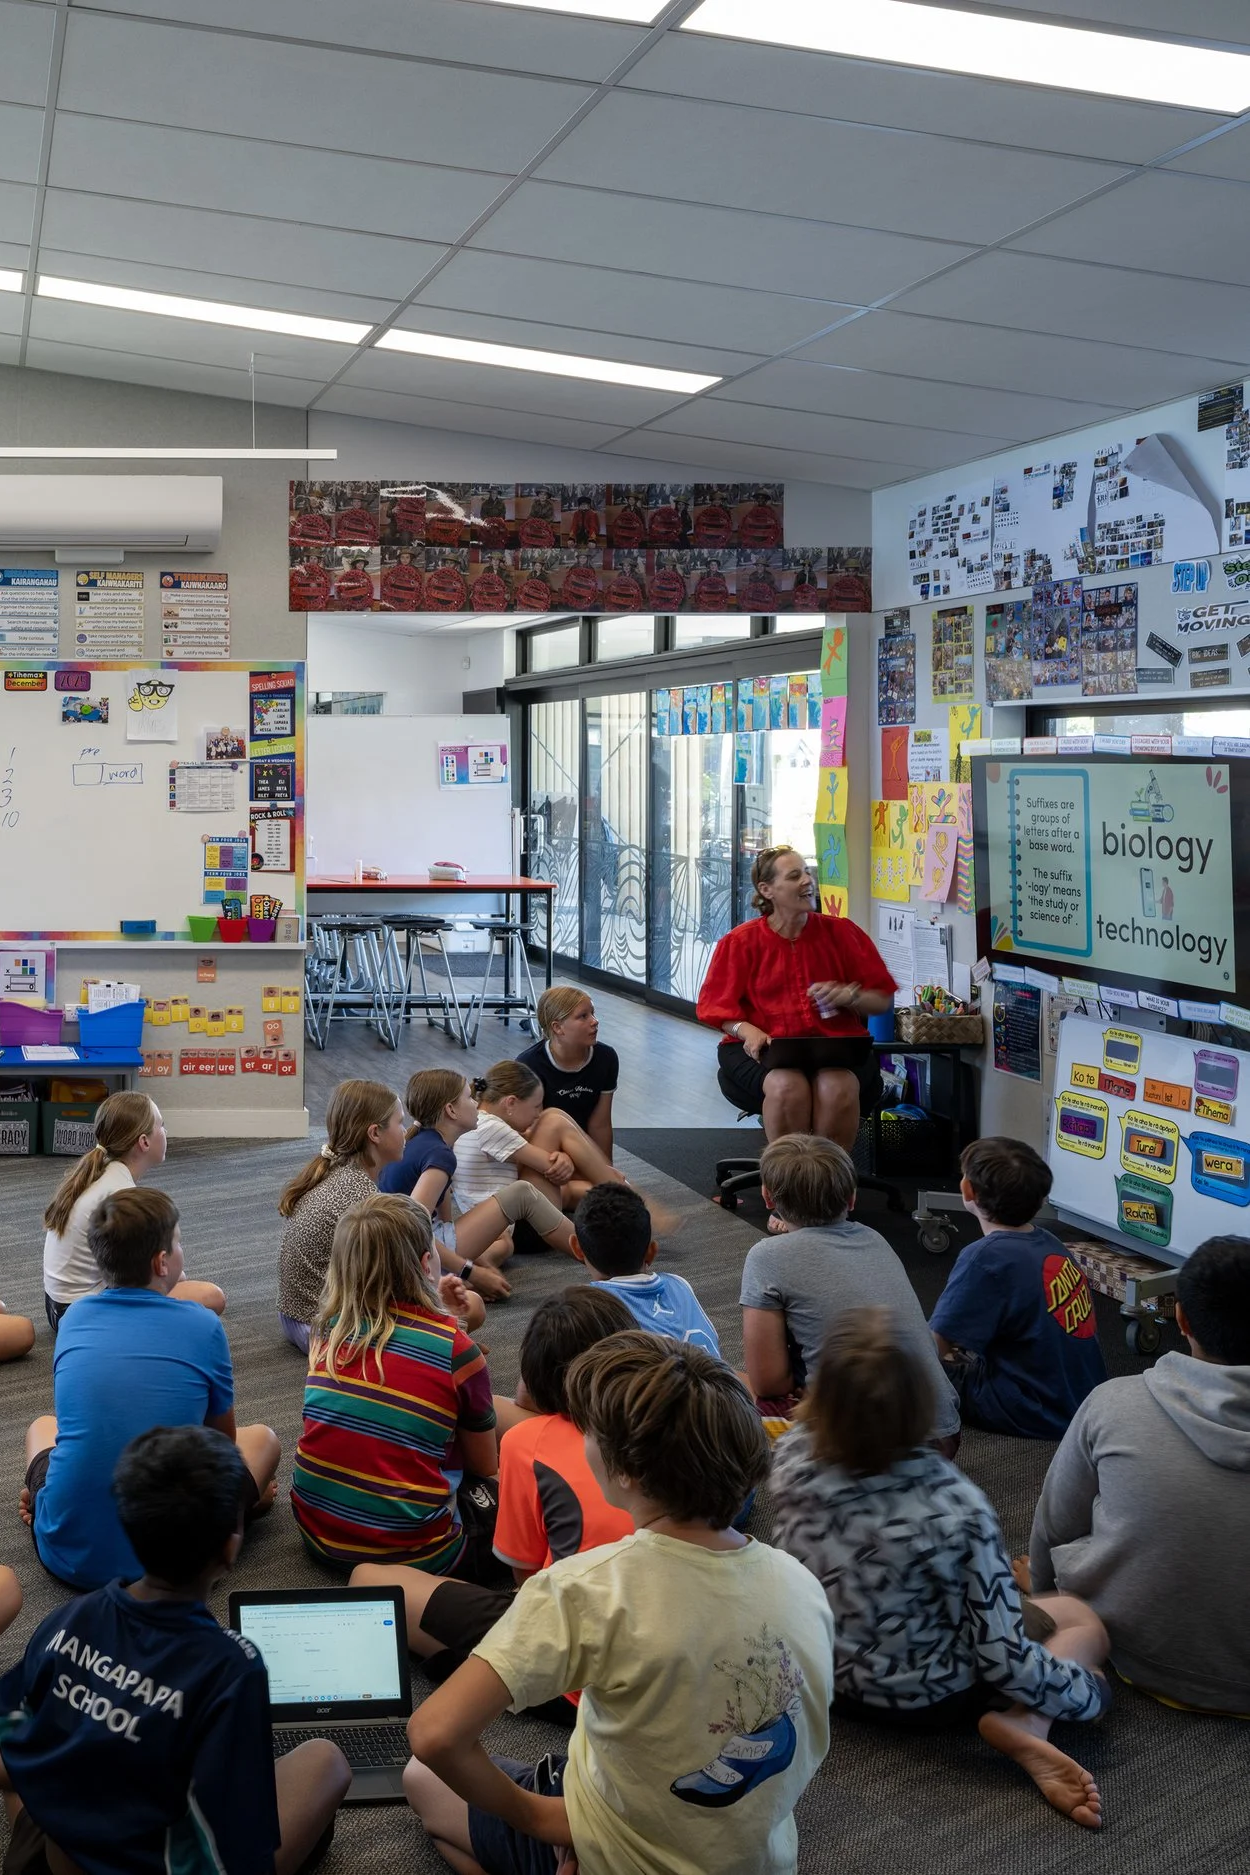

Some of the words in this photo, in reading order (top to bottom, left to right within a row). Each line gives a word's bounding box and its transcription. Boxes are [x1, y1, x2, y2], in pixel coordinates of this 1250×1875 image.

[1172, 562, 1195, 592] STEP
[1196, 561, 1208, 591] UP
[1192, 600, 1249, 618] GET
[1177, 615, 1250, 633] MOVING
[7, 679, 44, 687] December
[2, 768, 14, 784] 2
[108, 767, 138, 781] word
[1026, 797, 1058, 810] Suffixes
[1060, 800, 1075, 810] are
[1, 810, 20, 828] 10
[250, 812, 266, 820] ROCK
[272, 810, 287, 818] ROLL
[1031, 814, 1060, 826] groups
[1061, 813, 1071, 824] of
[1023, 825, 1049, 838] letters
[1051, 827, 1071, 839] after
[1073, 831, 1080, 839] a
[1029, 839, 1049, 851] base
[1050, 842, 1075, 854] word.
[1101, 821, 1214, 875] biology
[1033, 867, 1048, 879] The
[1050, 869, 1073, 882] suffix
[1052, 886, 1082, 898] means
[1045, 897, 1068, 913] study
[1070, 902, 1079, 912] or
[1030, 910, 1060, 923] science
[1096, 914, 1228, 966] technology
[157, 1065, 169, 1074] oy
[182, 1062, 196, 1071] air
[245, 1061, 255, 1069] er
[262, 1062, 273, 1070] ar
[282, 1065, 292, 1073] or
[1073, 1070, 1085, 1083] Ko
[1086, 1072, 1095, 1085] te
[1103, 1078, 1131, 1097] Mane
[1202, 1104, 1229, 1121] Tihema
[56, 1129, 77, 1146] WORD
[79, 1130, 96, 1147] WOR
[1204, 1158, 1233, 1172] wera
[44, 1628, 185, 1720] MANGAPAPA
[51, 1673, 143, 1744] SCHOOL
[316, 1706, 332, 1714] acer
